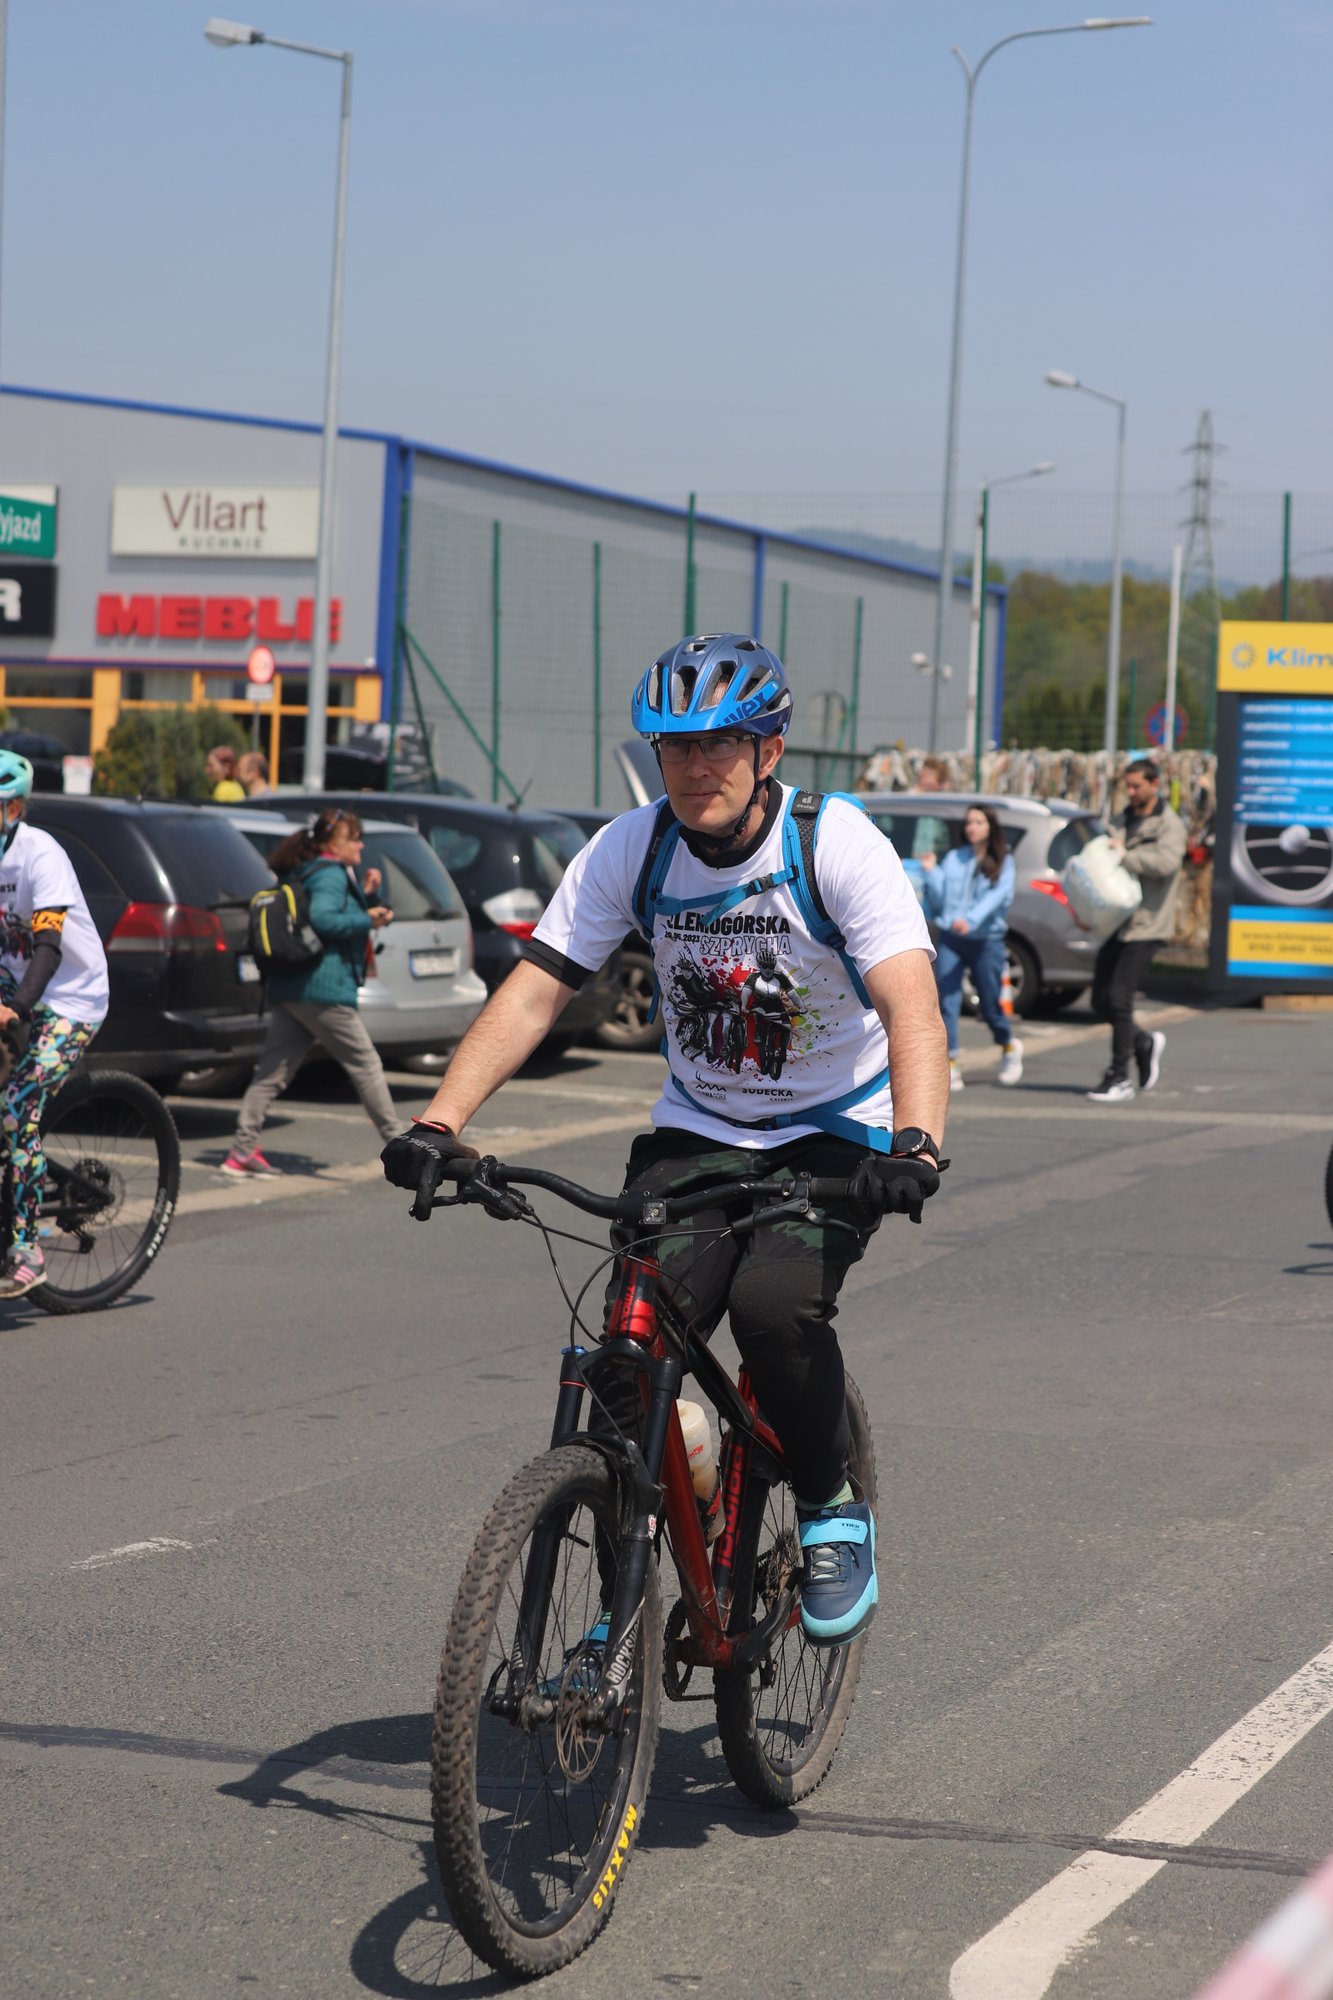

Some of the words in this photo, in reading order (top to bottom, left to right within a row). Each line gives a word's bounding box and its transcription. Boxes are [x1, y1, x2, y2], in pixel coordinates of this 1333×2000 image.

[161, 490, 268, 532] Vilart
[700, 935, 792, 957] SZPRYCHA
[592, 1803, 638, 1910] MAXXIS
